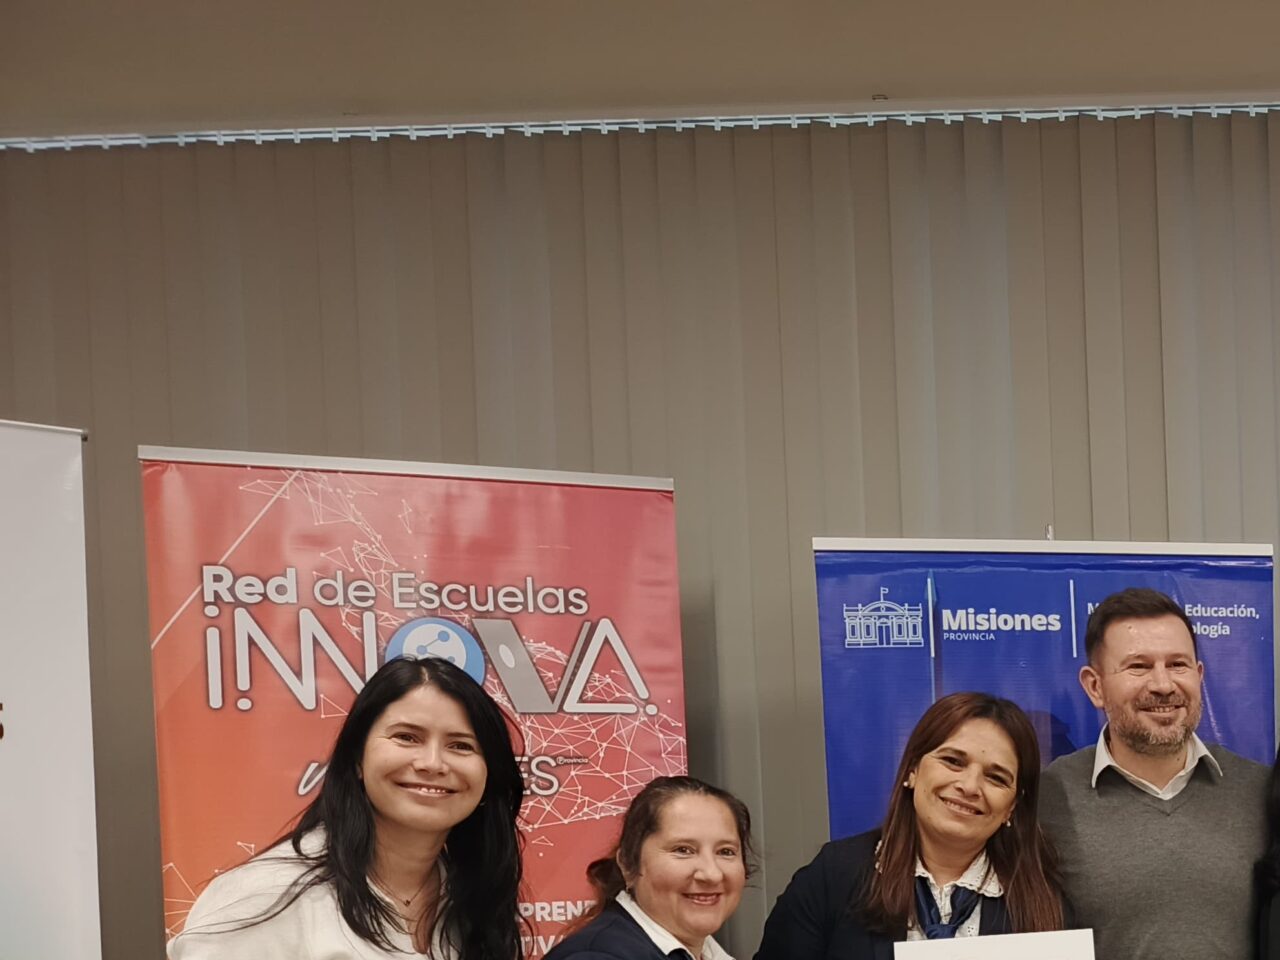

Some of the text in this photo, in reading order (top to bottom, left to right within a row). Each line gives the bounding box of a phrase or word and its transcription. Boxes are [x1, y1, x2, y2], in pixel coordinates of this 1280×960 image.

[202, 565, 588, 616] Red de Escuelas
[942, 608, 1062, 632] Misiones
[1184, 604, 1260, 619] Educación,
[943, 632, 996, 641] PROVINCIA
